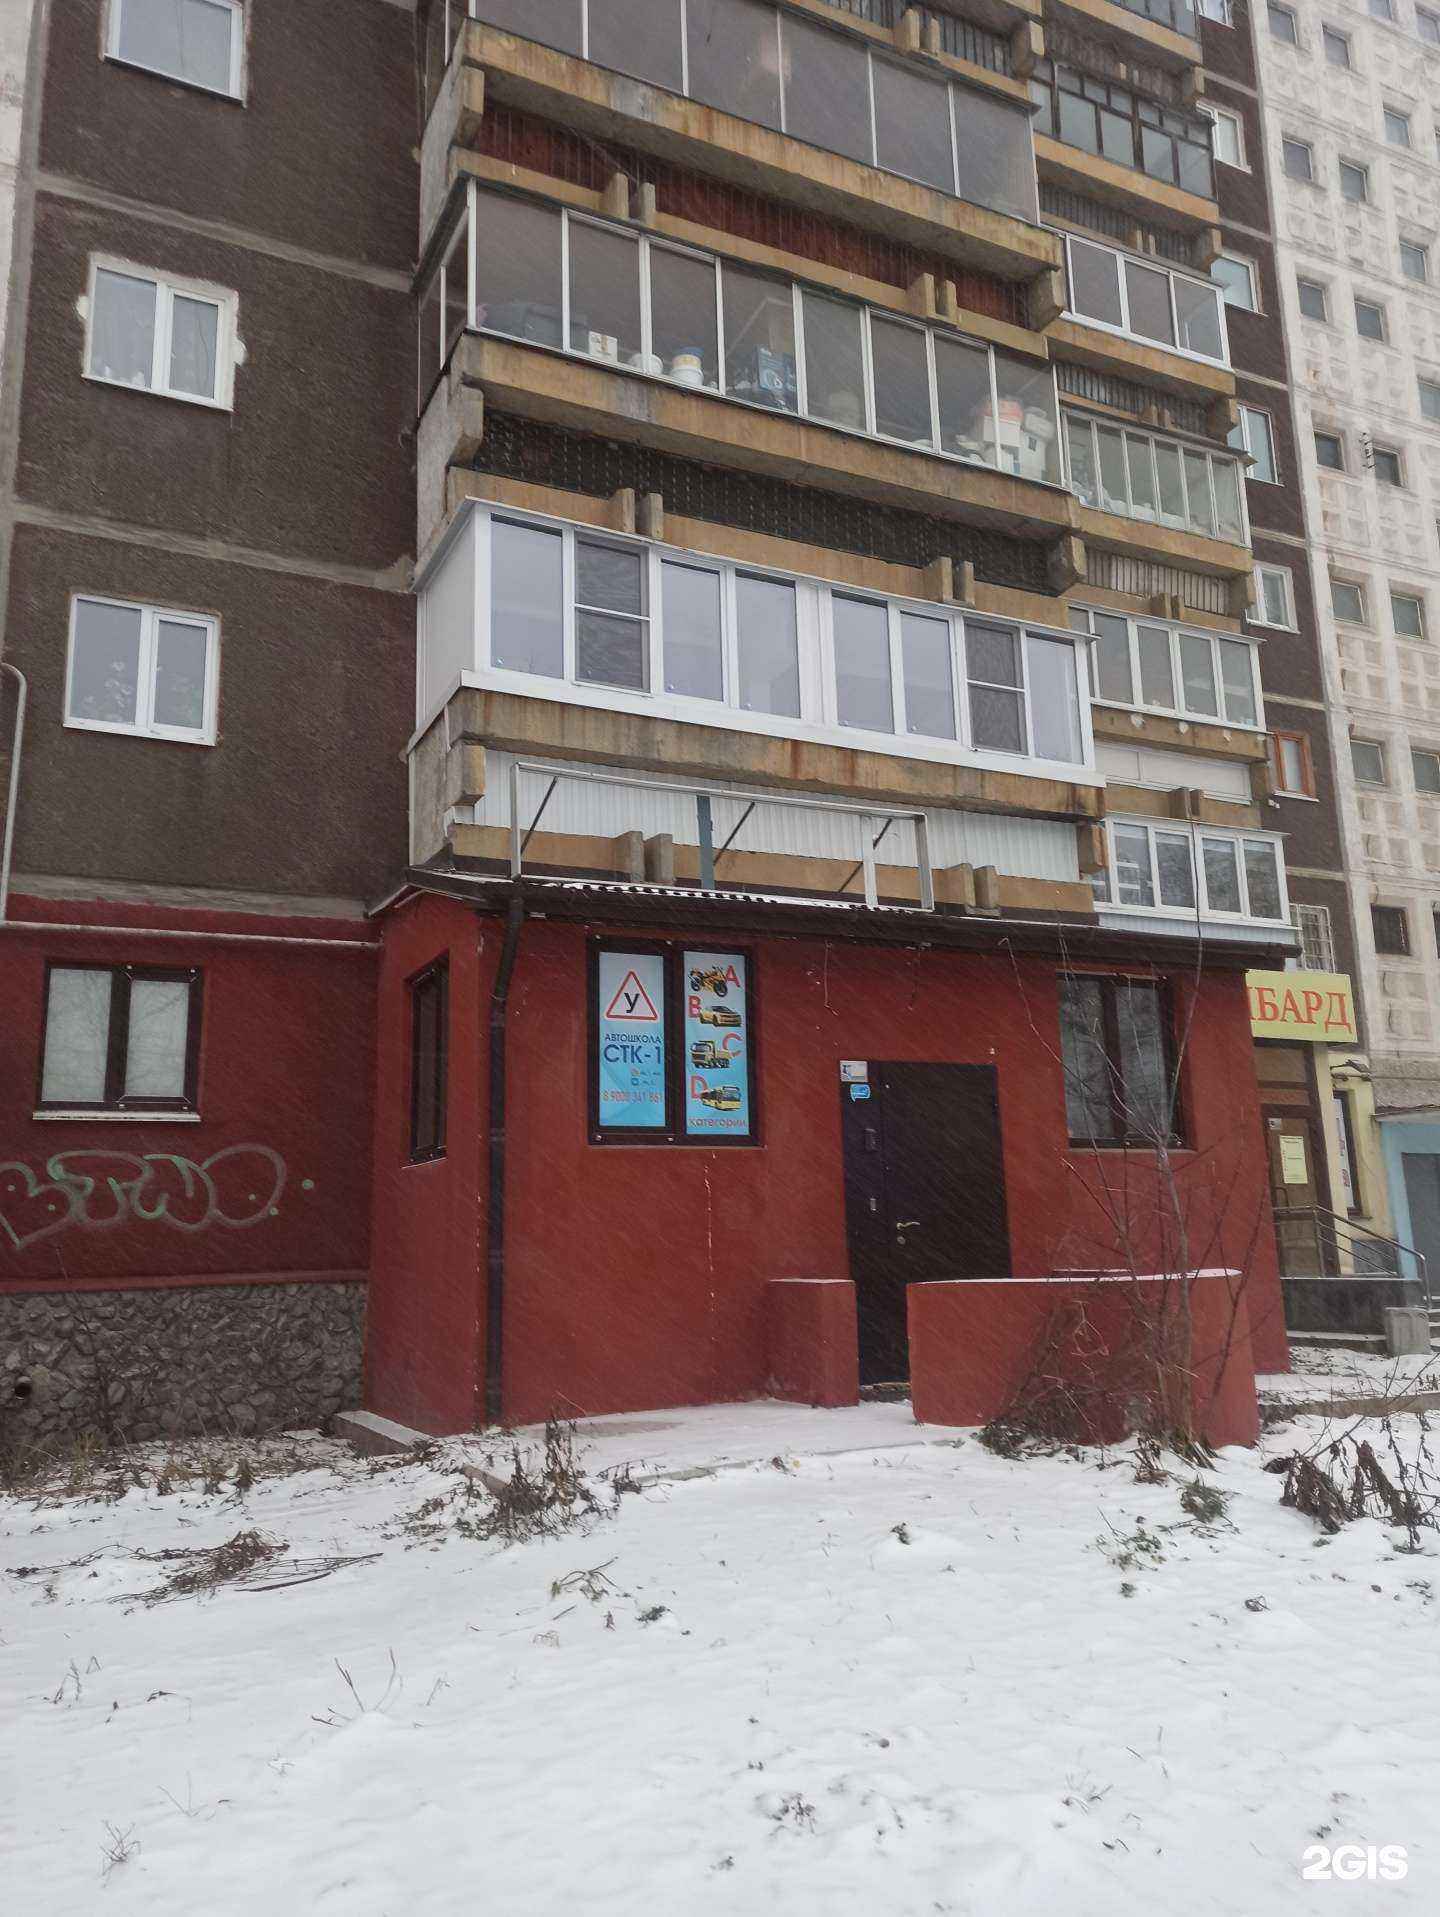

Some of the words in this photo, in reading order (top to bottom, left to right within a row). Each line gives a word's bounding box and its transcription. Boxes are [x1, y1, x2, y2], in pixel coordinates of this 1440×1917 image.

[725, 965, 741, 988] A
[688, 995, 702, 1018] B
[605, 1033, 662, 1043] АВТОШКОЛА
[722, 1032, 743, 1056] C
[690, 1075, 709, 1099] D
